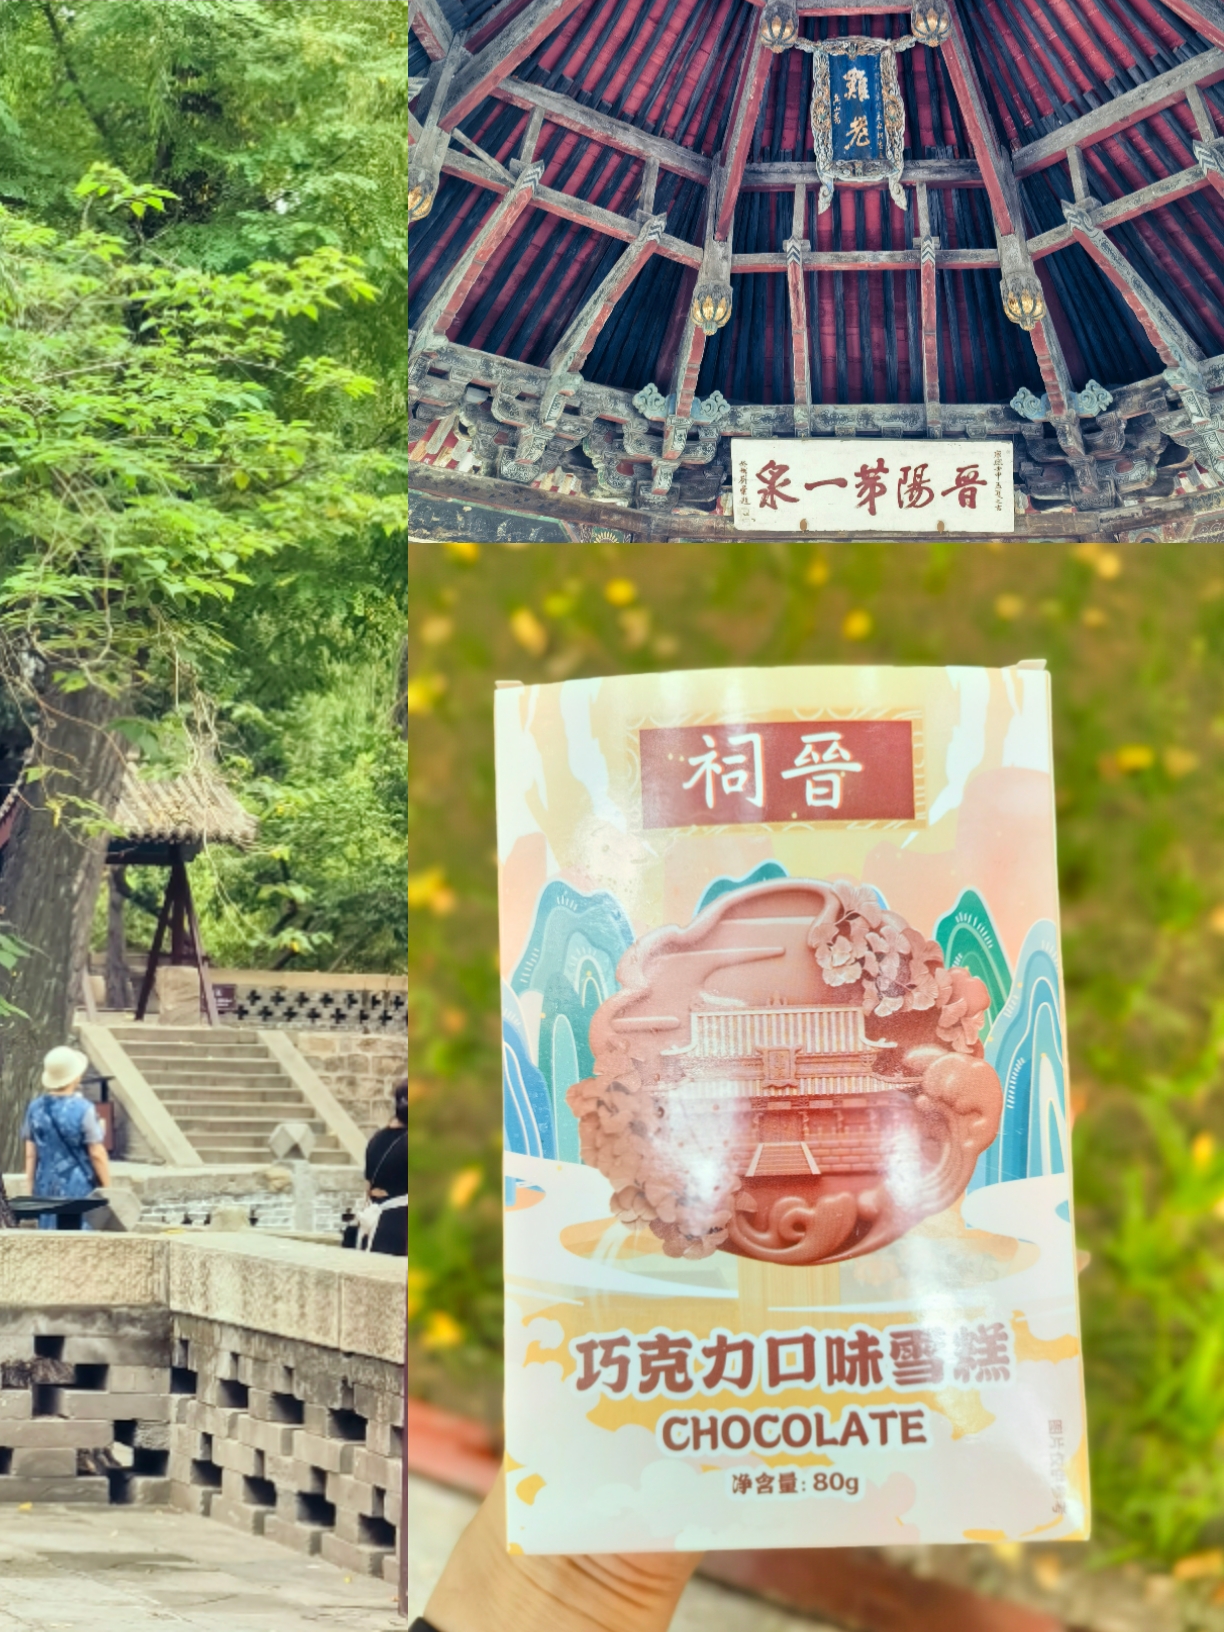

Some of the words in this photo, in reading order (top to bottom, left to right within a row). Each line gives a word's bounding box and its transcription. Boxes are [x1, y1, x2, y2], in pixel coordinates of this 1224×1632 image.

[575, 1321, 1011, 1394] 巧克力口味雪糕
[661, 1409, 928, 1452] CHOCOLATE
